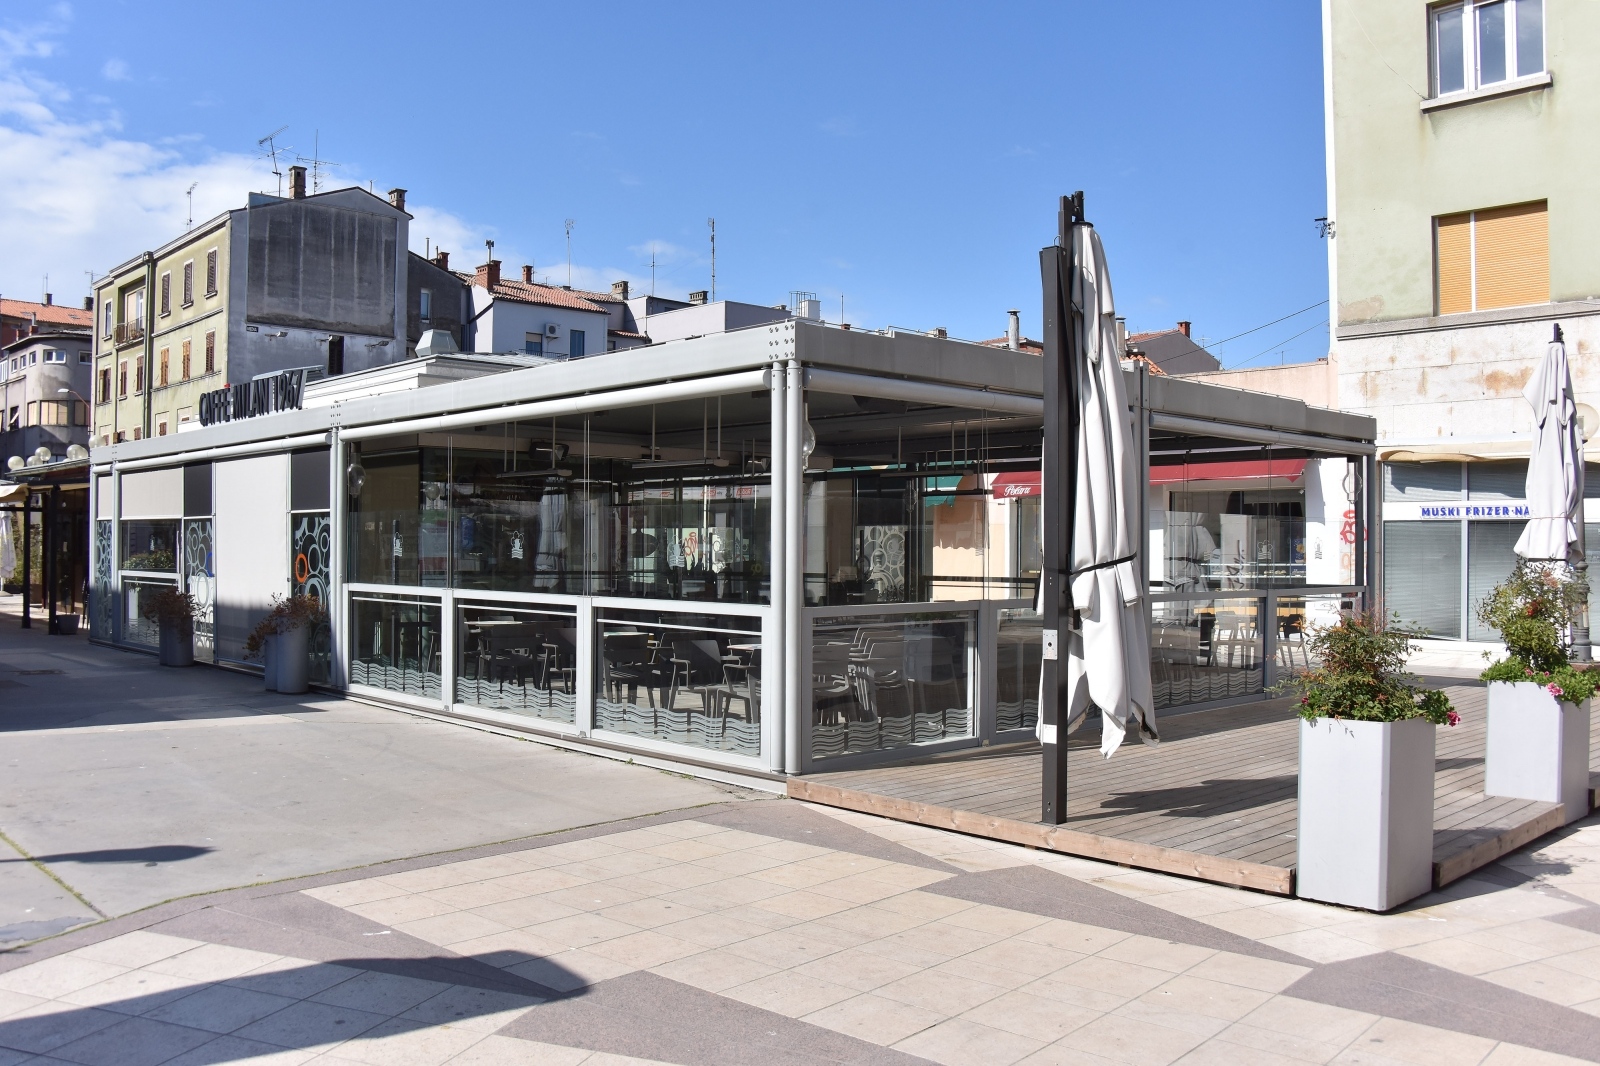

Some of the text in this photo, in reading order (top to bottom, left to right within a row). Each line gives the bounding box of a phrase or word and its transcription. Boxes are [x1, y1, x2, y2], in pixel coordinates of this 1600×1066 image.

[233, 377, 270, 421] MILAN
[273, 369, 305, 413] 1967
[1466, 506, 1510, 516] FRIZER
